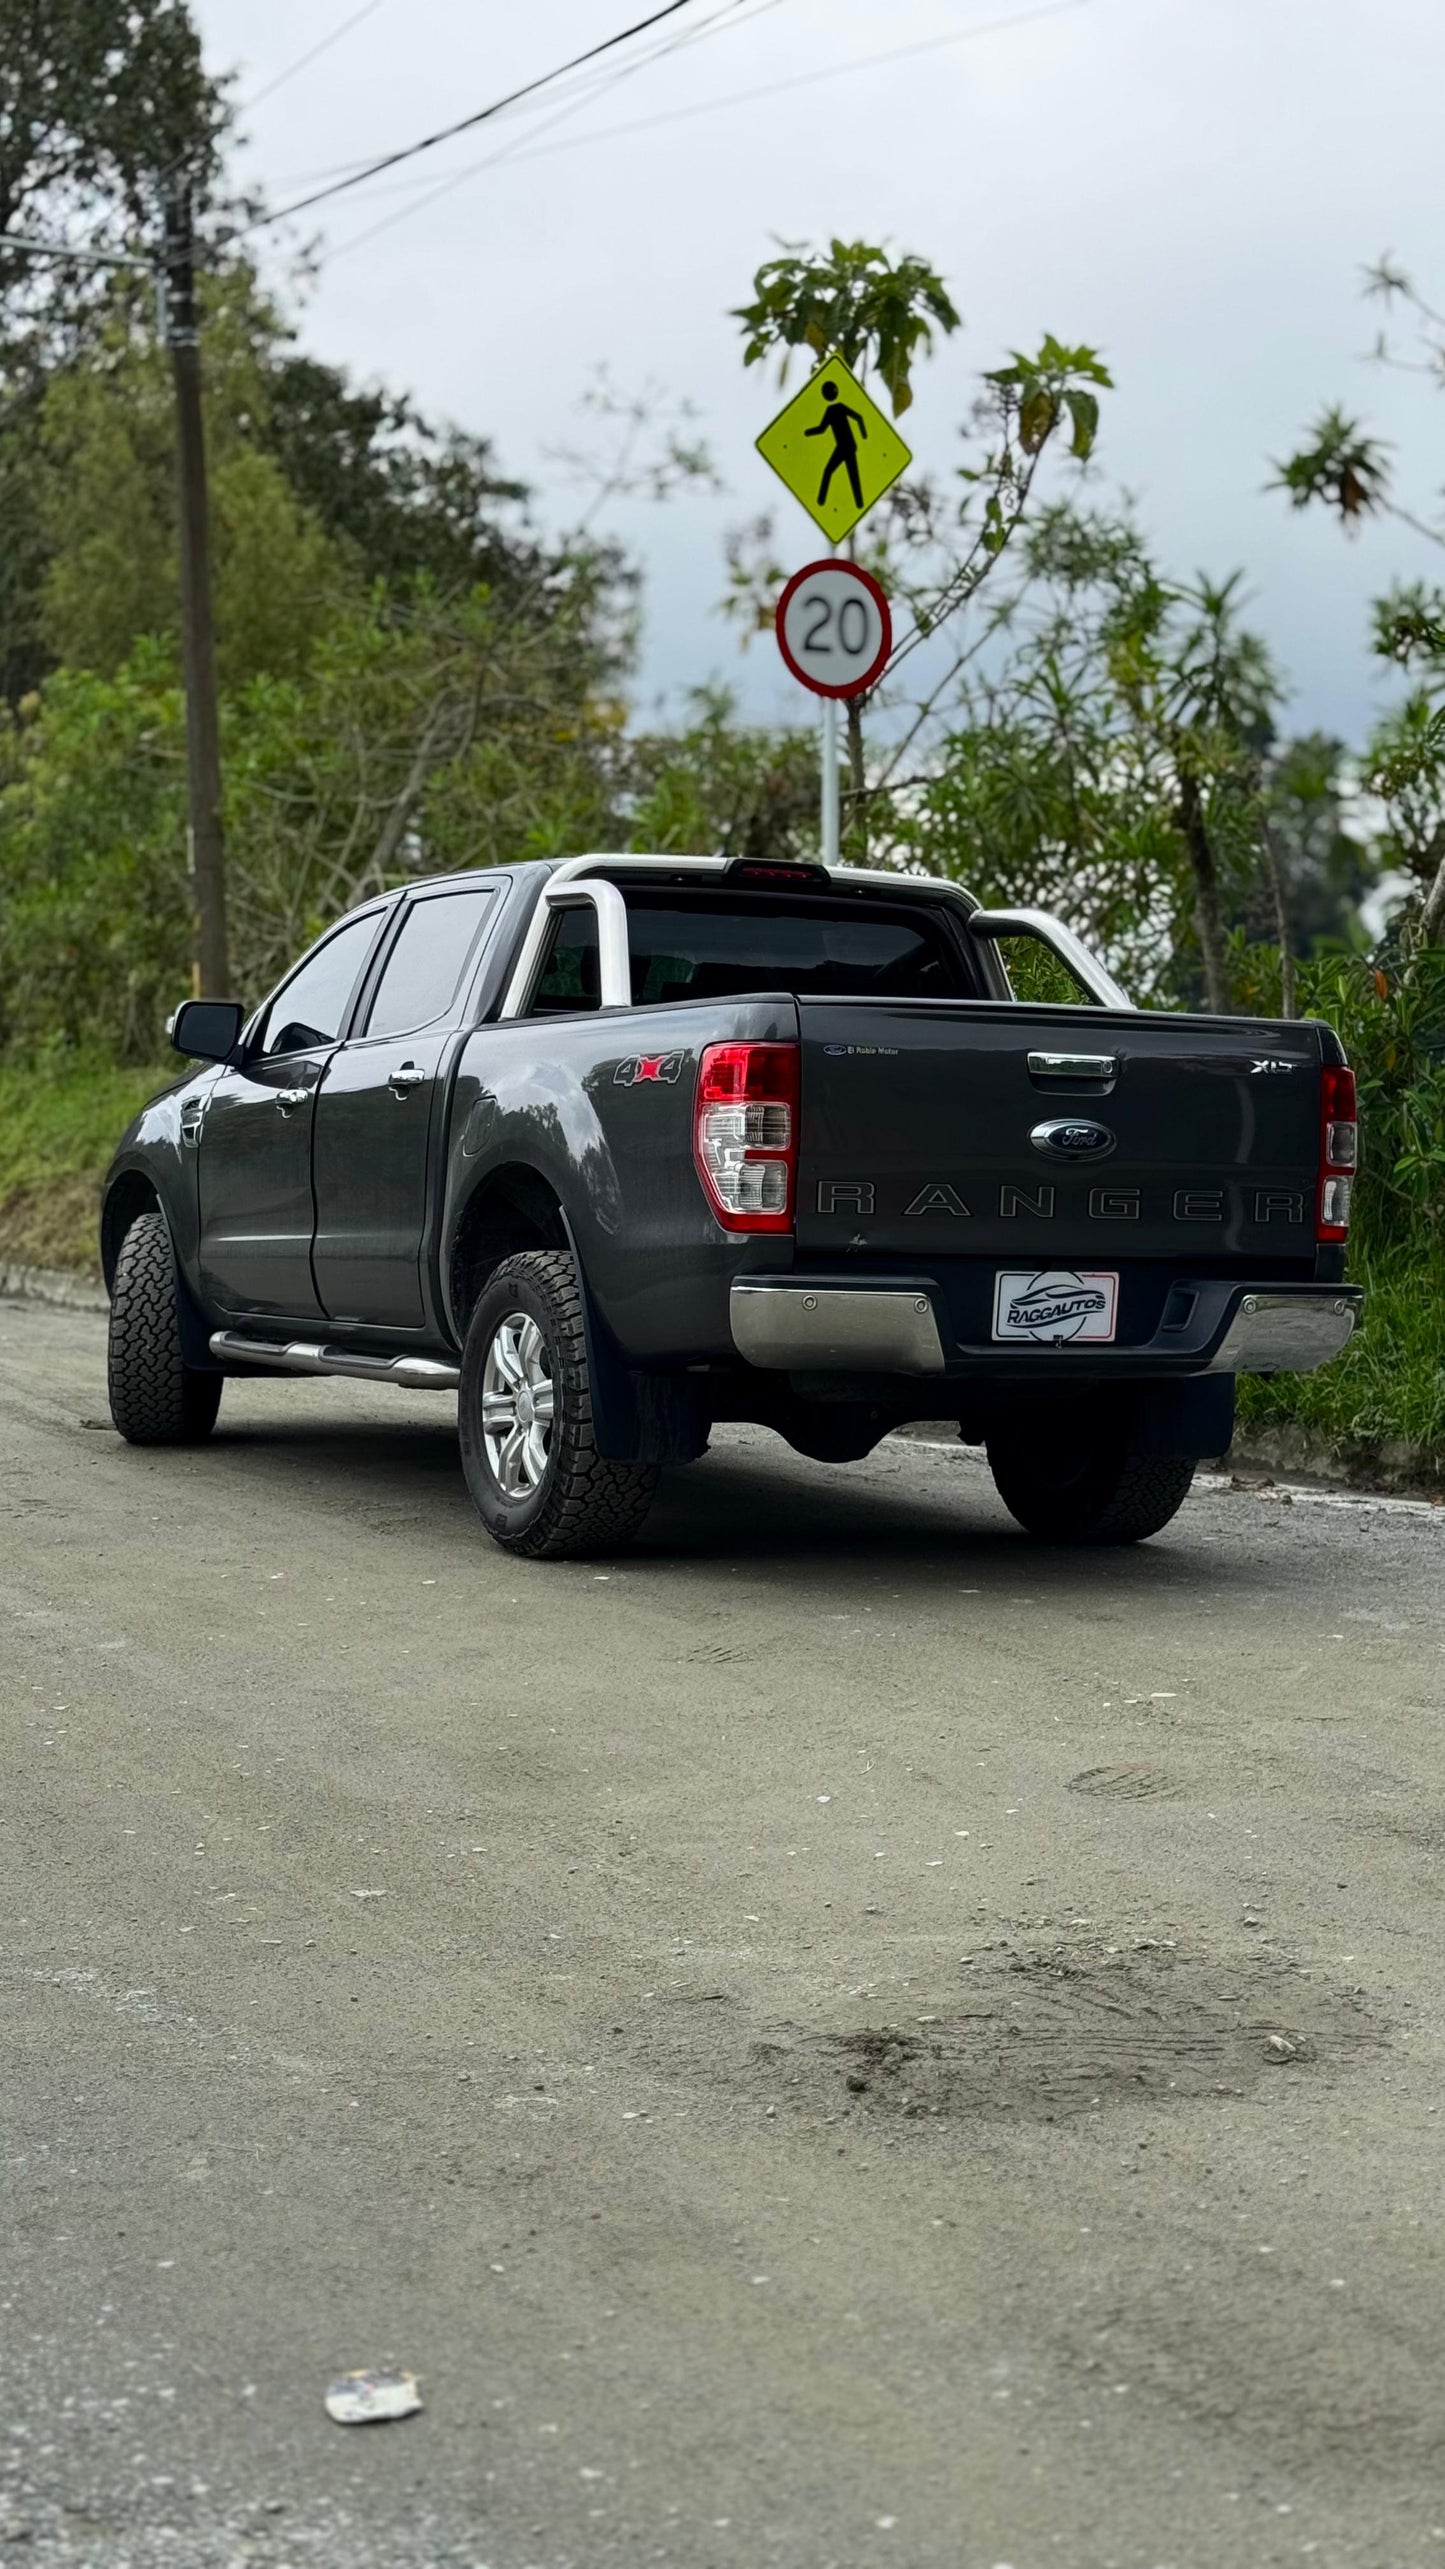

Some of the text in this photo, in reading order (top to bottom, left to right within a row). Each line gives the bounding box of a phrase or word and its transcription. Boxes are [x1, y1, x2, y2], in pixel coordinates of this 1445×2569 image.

[803, 595, 869, 656] 20
[1250, 1060, 1297, 1074] XLT
[1062, 1127, 1098, 1146] Ford
[816, 1180, 1305, 1223] RANGER
[1007, 1299, 1106, 1324] RAGGAUTOS
